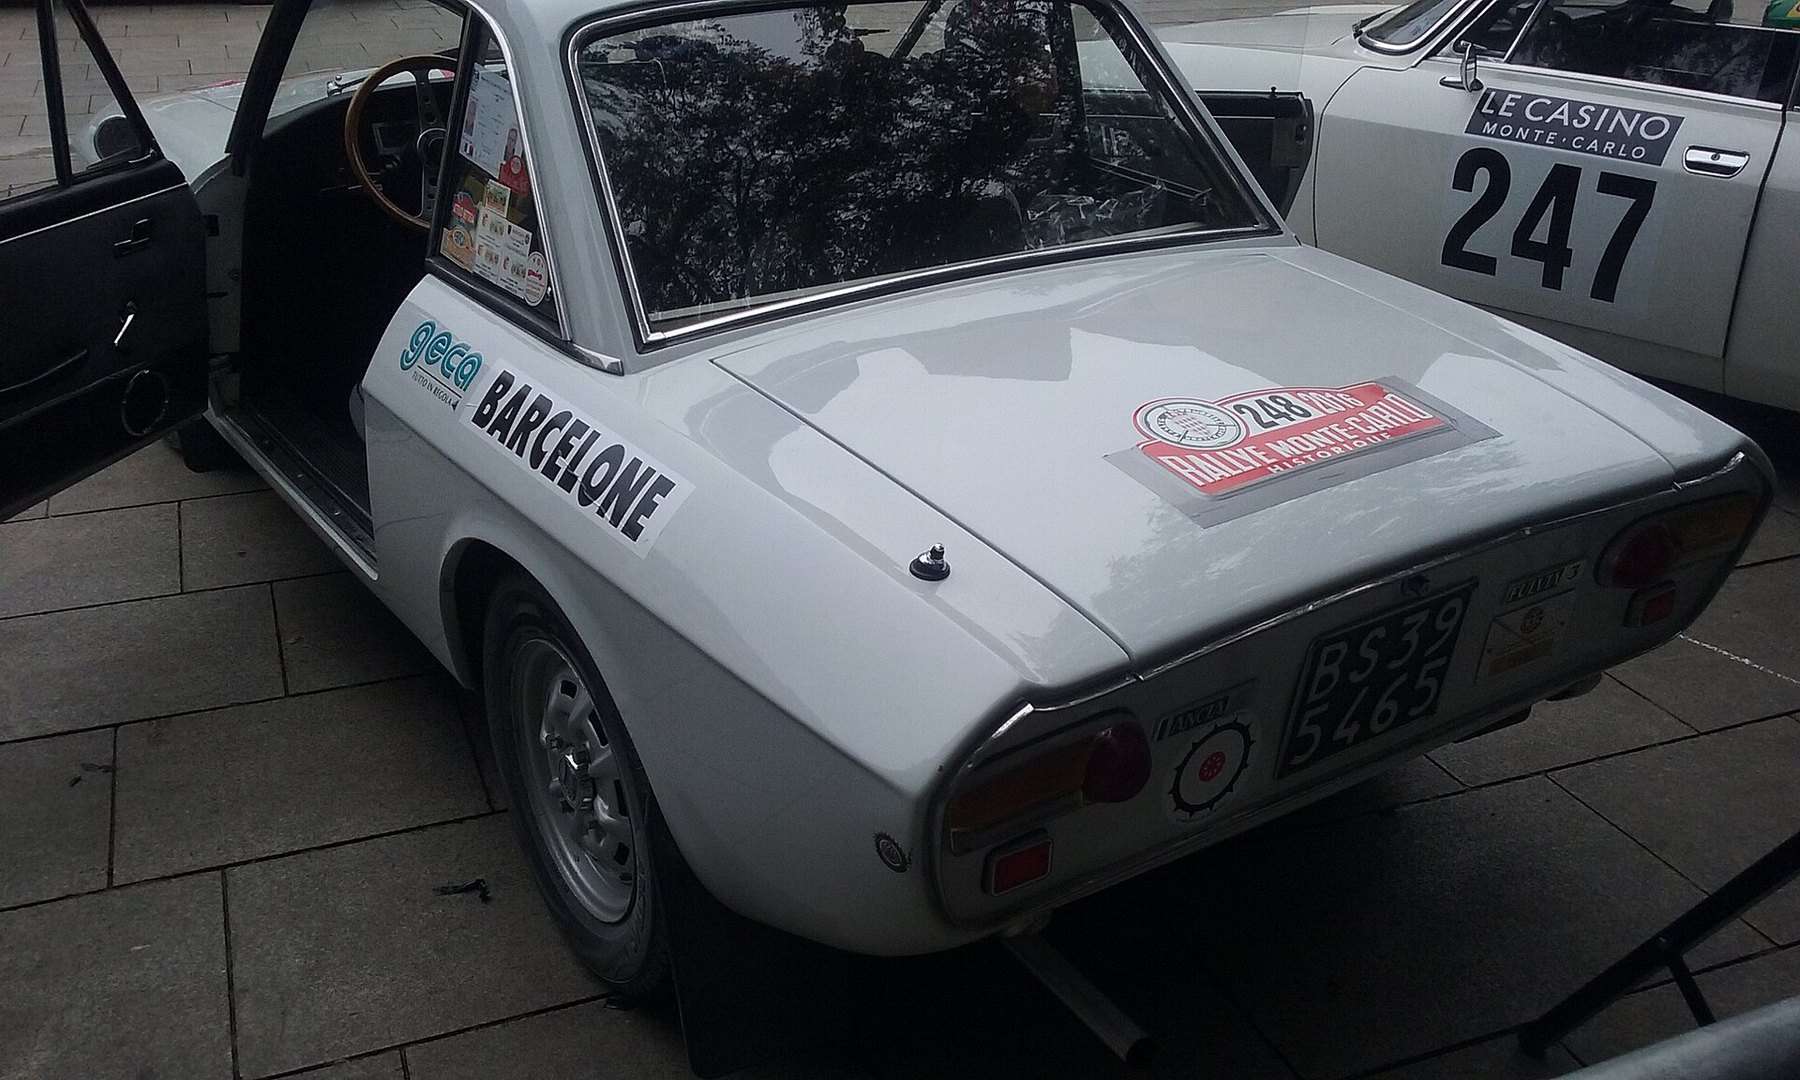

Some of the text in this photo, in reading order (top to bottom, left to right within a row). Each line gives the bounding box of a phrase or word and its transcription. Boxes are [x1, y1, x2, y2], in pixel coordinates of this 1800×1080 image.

[1482, 91, 1671, 141] LE CASINO
[1441, 147, 1658, 303] 247
[400, 320, 484, 392] geca
[1157, 445, 1282, 487] RALLYE
[1265, 393, 1434, 458] MONTE-CARLO
[1233, 394, 1312, 430] 248
[1266, 432, 1392, 474] HISTORIQUE
[471, 369, 677, 542] BARCELONE
[1290, 655, 1448, 768] 5465
